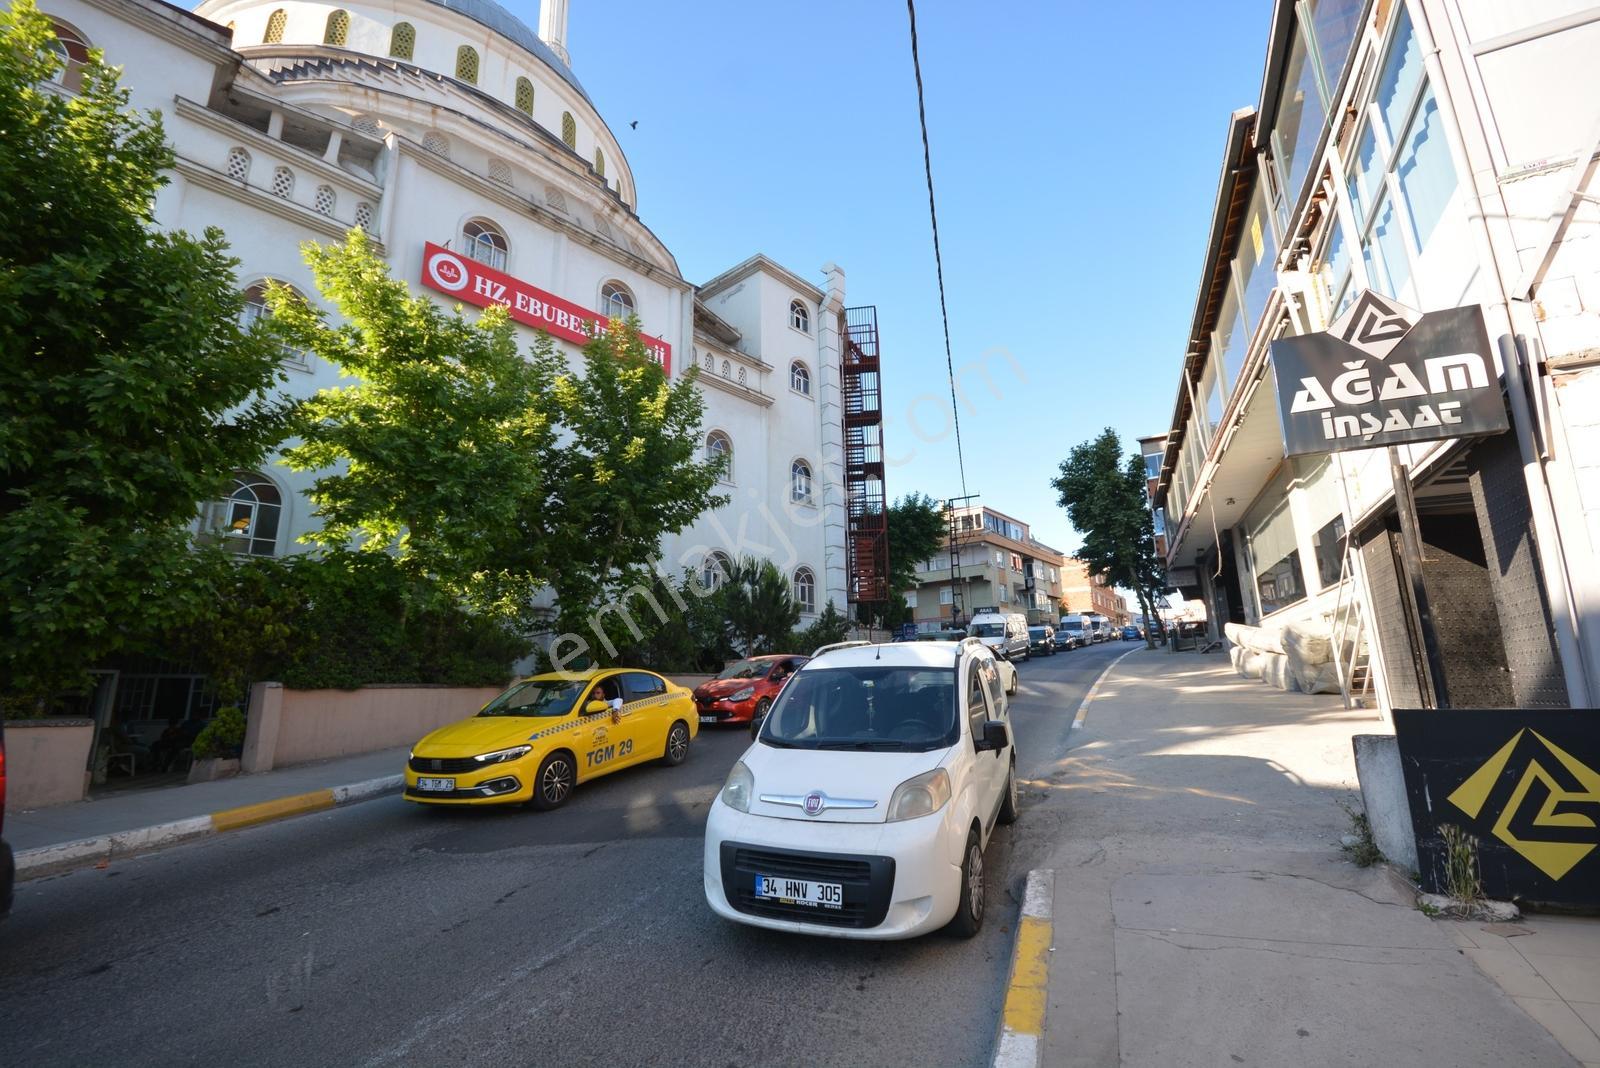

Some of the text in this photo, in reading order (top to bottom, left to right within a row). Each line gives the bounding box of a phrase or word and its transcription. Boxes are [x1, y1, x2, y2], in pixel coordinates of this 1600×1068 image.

[1291, 353, 1489, 414] AĞAM
[586, 738, 634, 767] TGM 29
[763, 878, 841, 903] 34 HNV 305
